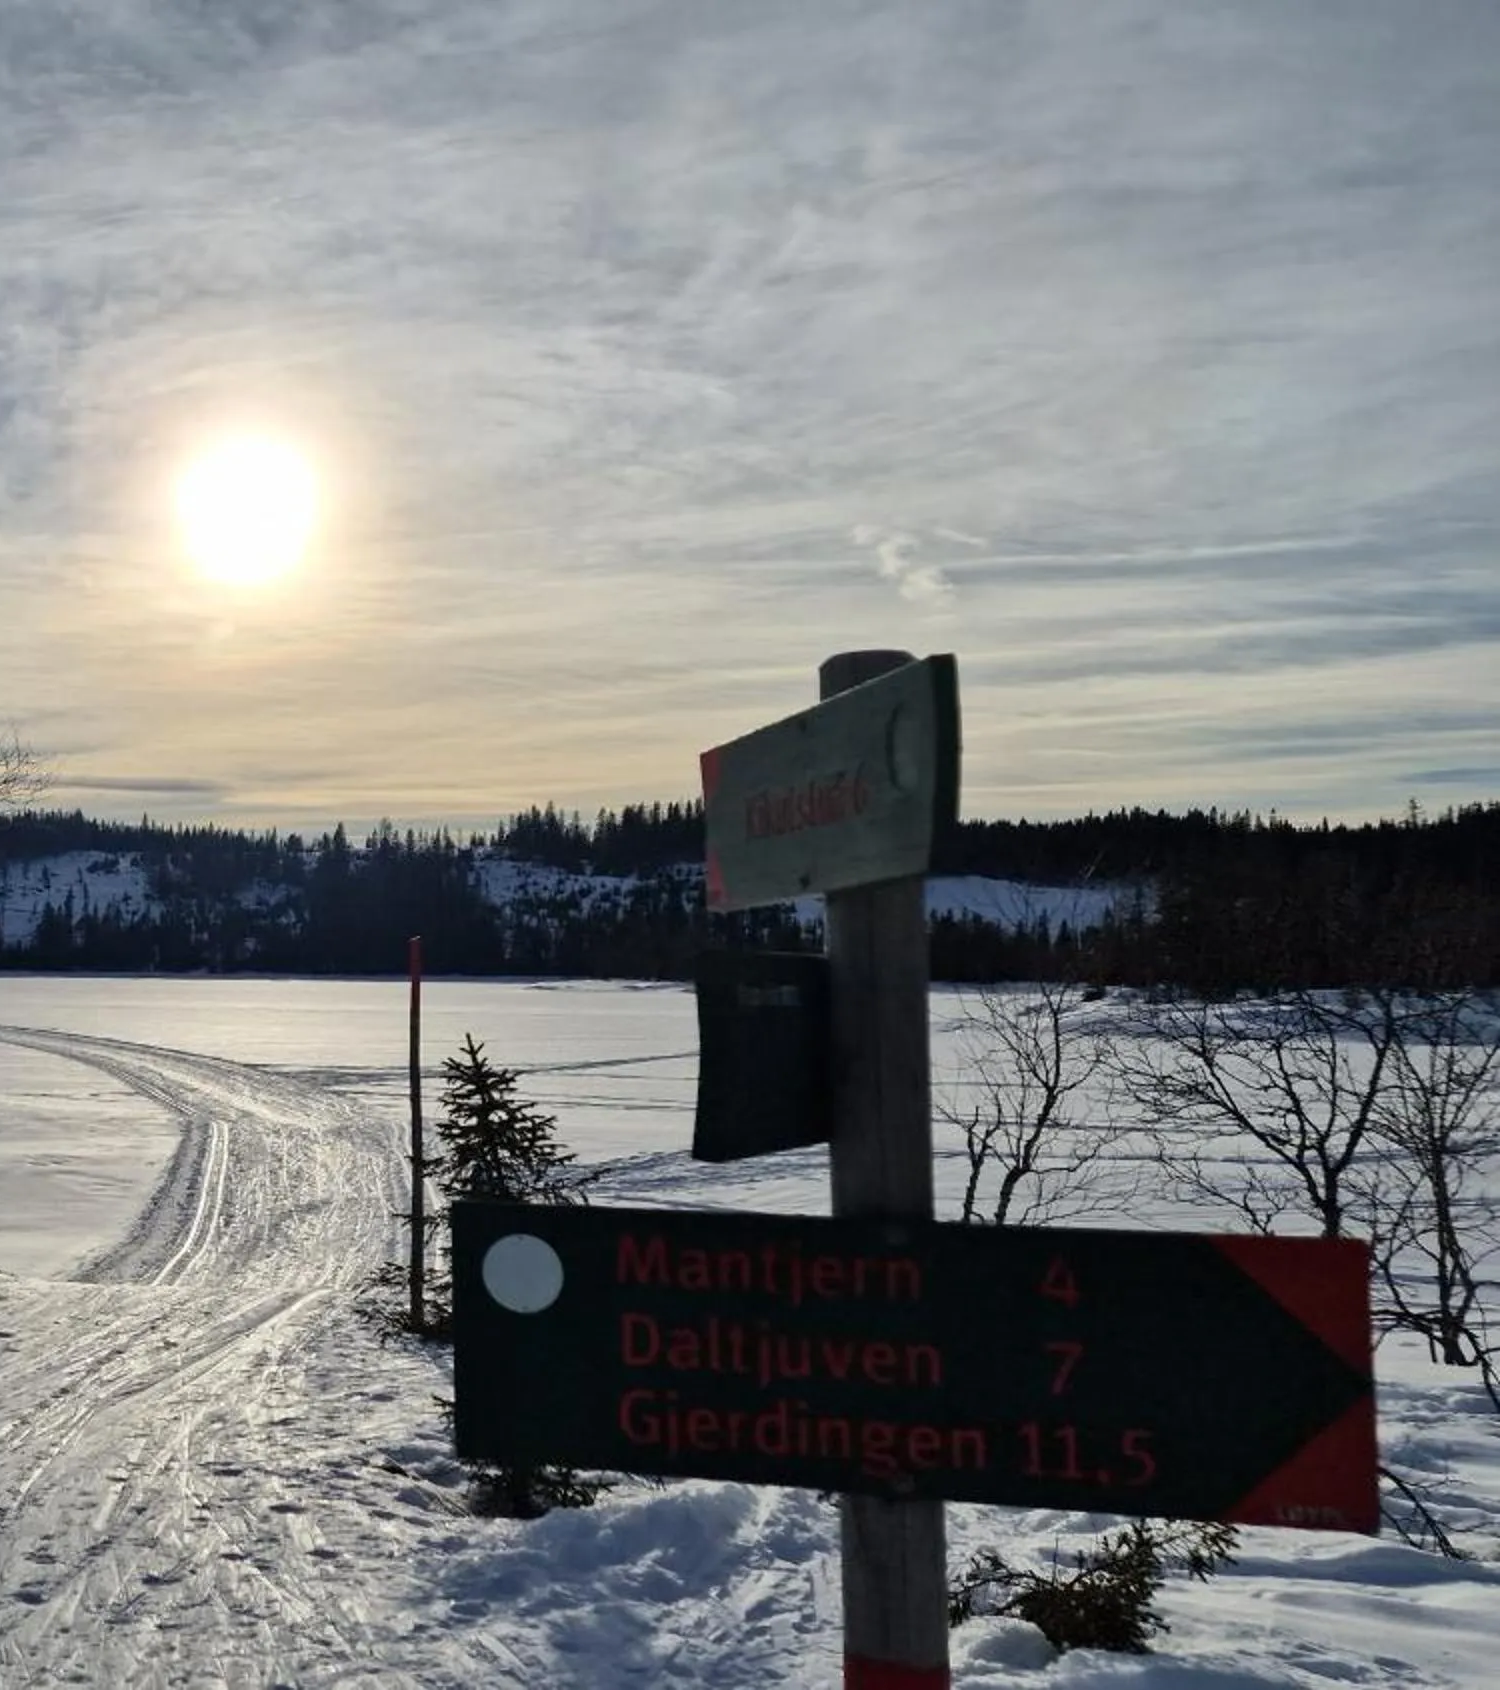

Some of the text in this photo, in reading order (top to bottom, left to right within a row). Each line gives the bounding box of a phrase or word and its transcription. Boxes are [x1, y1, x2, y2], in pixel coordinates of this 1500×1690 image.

[616, 1234, 1080, 1308] Mantjern 4
[619, 1312, 1084, 1396] Daltjuven 7
[619, 1389, 987, 1478] Gjerdingen
